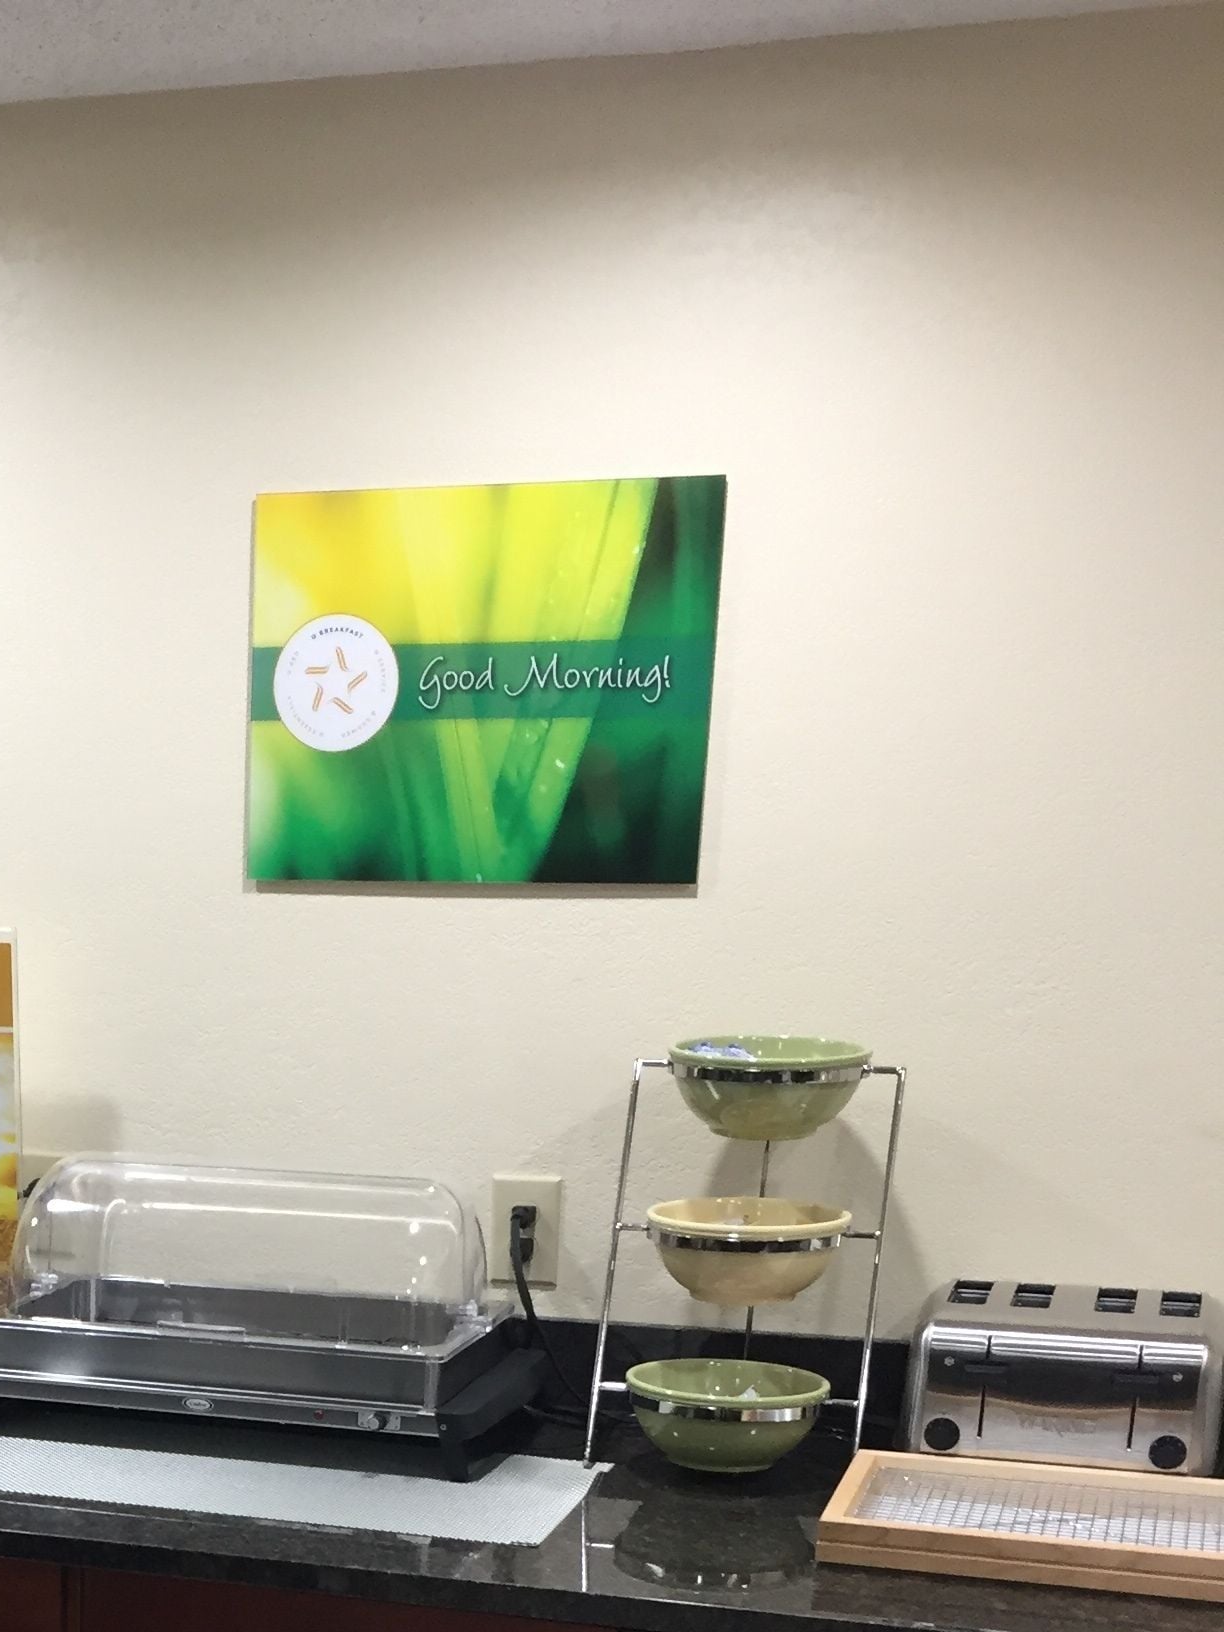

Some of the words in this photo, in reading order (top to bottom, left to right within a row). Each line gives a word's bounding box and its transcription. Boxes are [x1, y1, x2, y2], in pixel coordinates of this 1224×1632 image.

[319, 627, 364, 639] BREAKFAST
[418, 656, 495, 709] Good
[504, 653, 671, 703] Morning!
